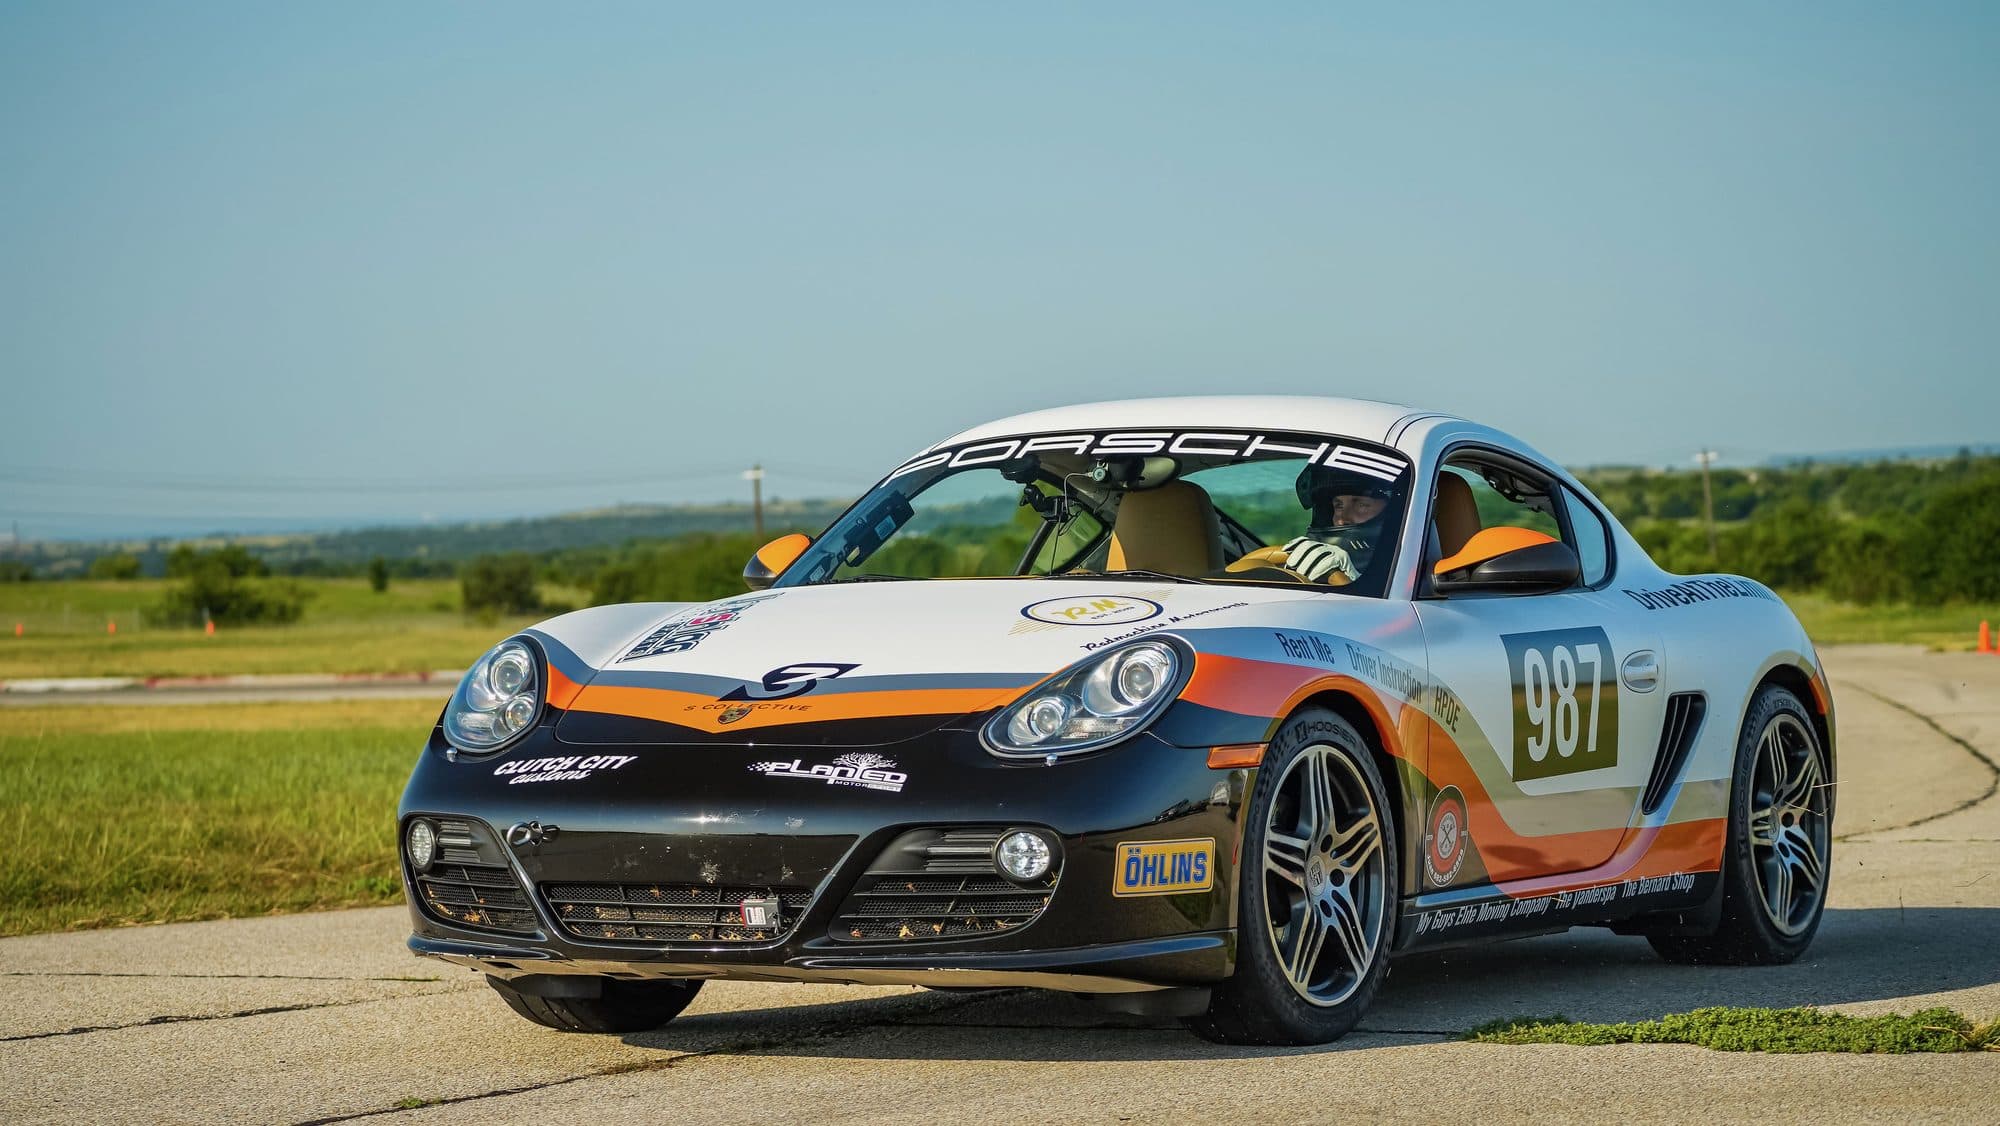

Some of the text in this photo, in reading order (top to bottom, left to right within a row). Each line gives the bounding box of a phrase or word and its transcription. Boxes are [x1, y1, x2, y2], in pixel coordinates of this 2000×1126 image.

[880, 433, 1408, 488] PORSCHE
[1622, 577, 1776, 610] DriveAtTheLim
[1275, 632, 1335, 664] Rent Me
[1345, 643, 1422, 704] Driver Instruction
[1434, 685, 1461, 733] HPDE
[1524, 643, 1602, 762] 987
[493, 755, 639, 776] CLUTCH CITY
[1124, 847, 1208, 887] ÖHLINS
[1621, 870, 1696, 898] The Bernard Shop
[1416, 896, 1552, 936] My Guys Elite Moving Company
[1555, 890, 1573, 910] The
